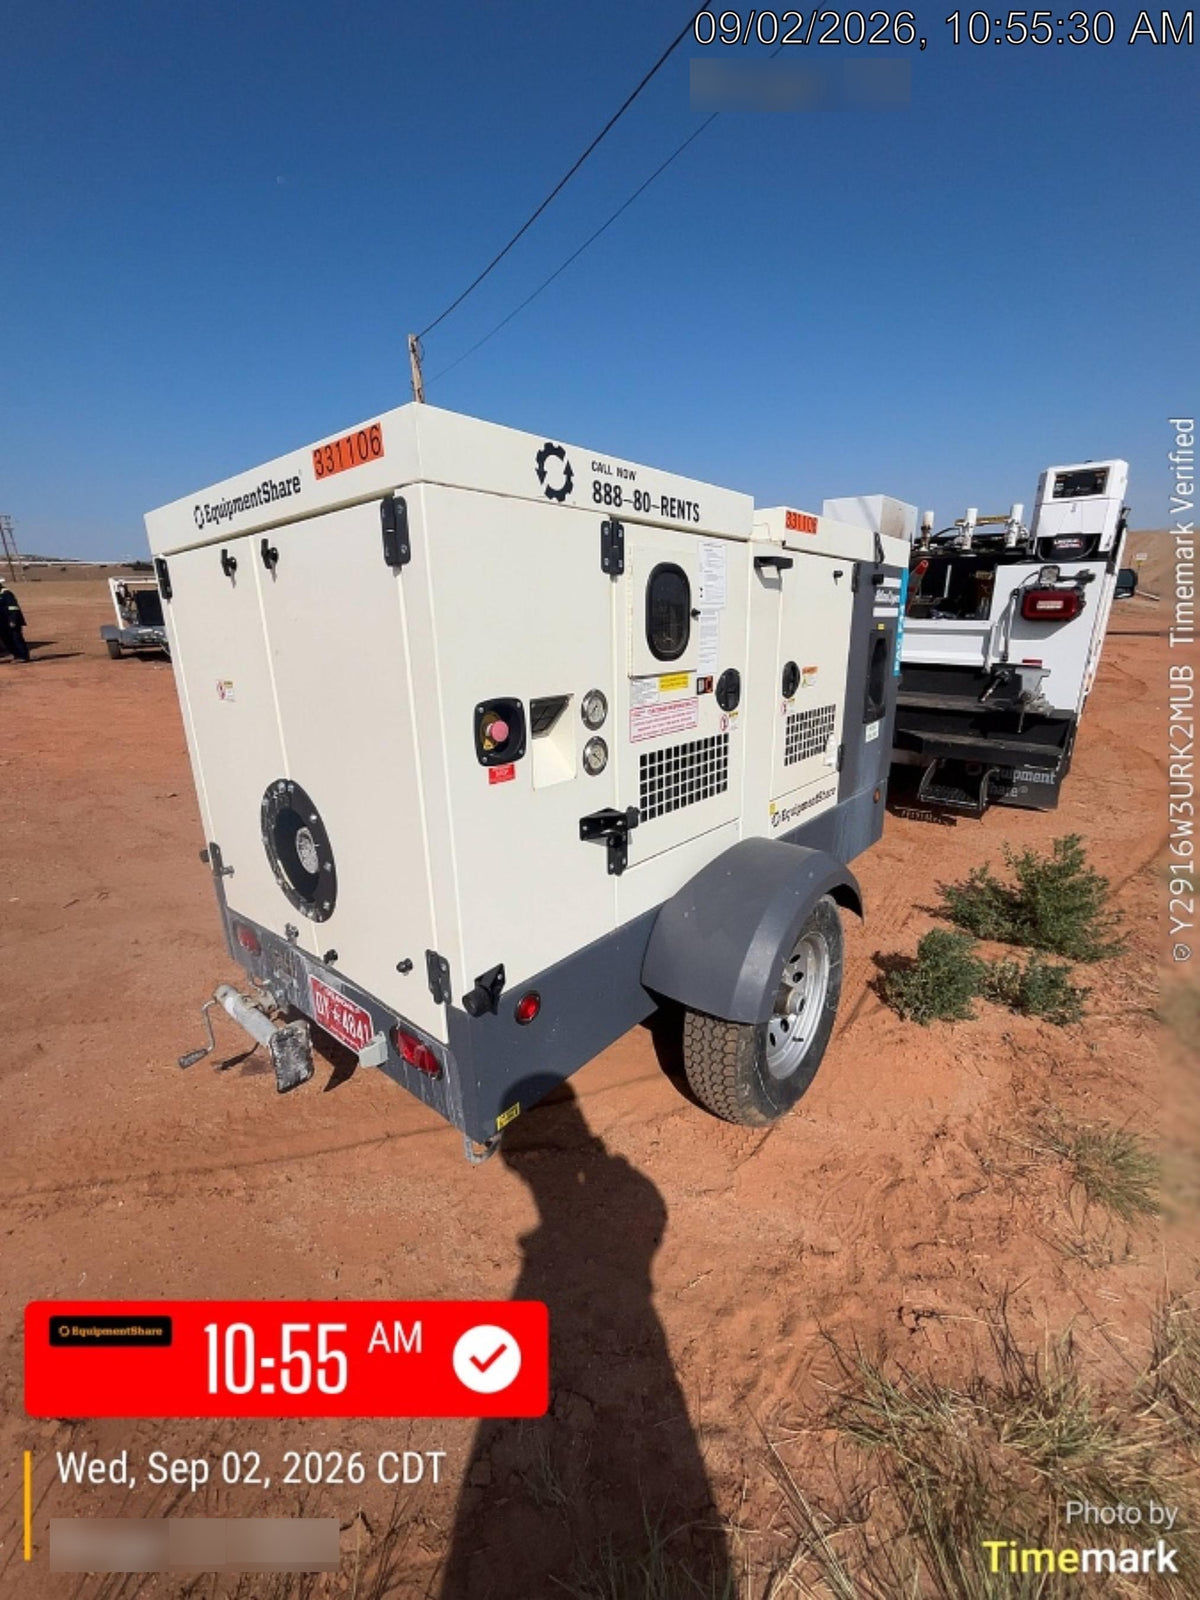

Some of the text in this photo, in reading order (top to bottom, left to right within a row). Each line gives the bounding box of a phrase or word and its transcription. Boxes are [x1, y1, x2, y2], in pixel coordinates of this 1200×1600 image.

[313, 424, 382, 476] 331106
[591, 460, 637, 480] CALL NOW
[205, 475, 302, 525] EquipmentShare
[592, 480, 700, 522] 888-80-RENTS
